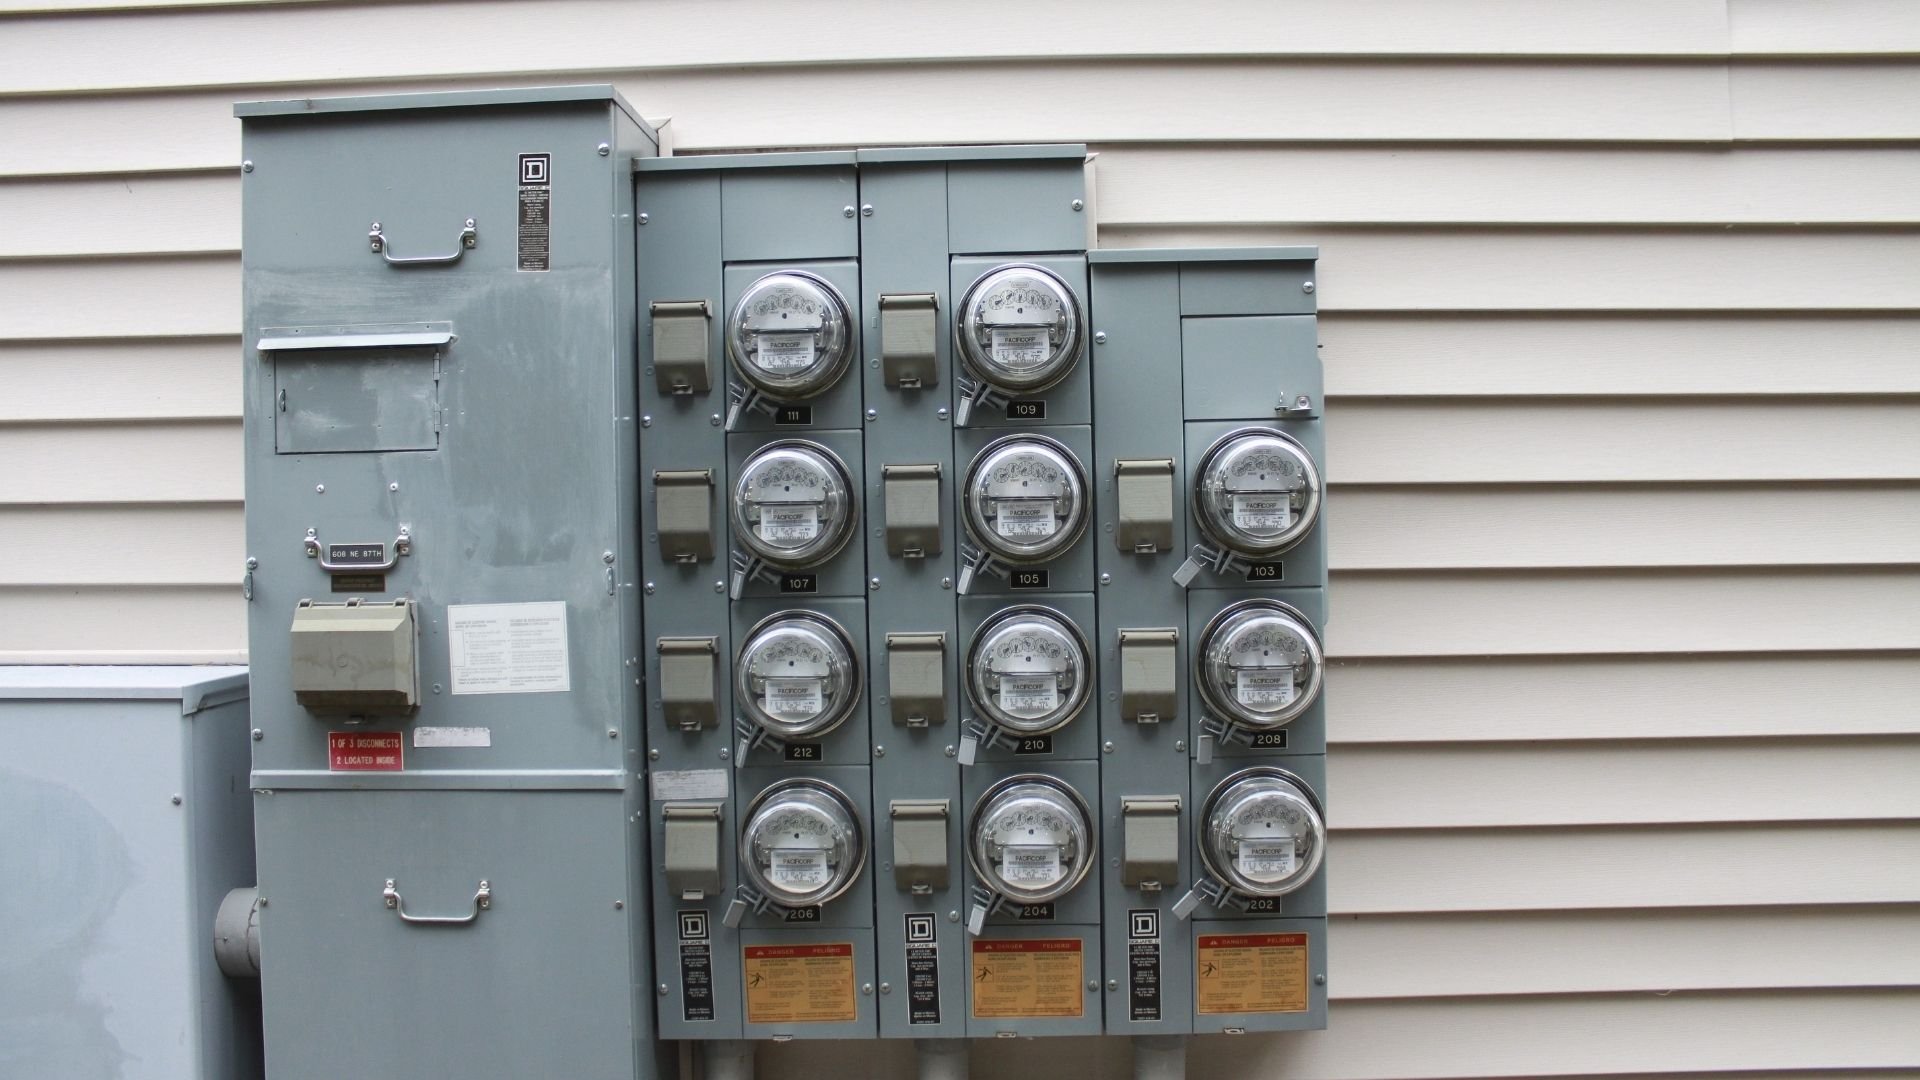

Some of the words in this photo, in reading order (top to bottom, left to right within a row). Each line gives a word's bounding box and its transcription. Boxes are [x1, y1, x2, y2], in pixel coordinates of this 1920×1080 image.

[1016, 405, 1036, 415] 109
[787, 411, 799, 421] 111
[350, 550, 359, 558] NE
[363, 550, 382, 558] 87TH
[1255, 567, 1275, 577] 103
[790, 579, 809, 588] 107
[1020, 574, 1039, 584] 105
[331, 738, 336, 748] 1
[337, 738, 346, 748] OF
[357, 738, 400, 748] DISCONNECTS
[1257, 734, 1281, 744] 208
[1025, 740, 1044, 749] 210
[794, 748, 812, 757] 212
[336, 756, 341, 765] 2
[344, 756, 373, 765] LOCATED
[376, 756, 396, 765] INSIDE
[1250, 900, 1273, 909] 202
[790, 909, 814, 919] 206
[1024, 906, 1048, 916] 204
